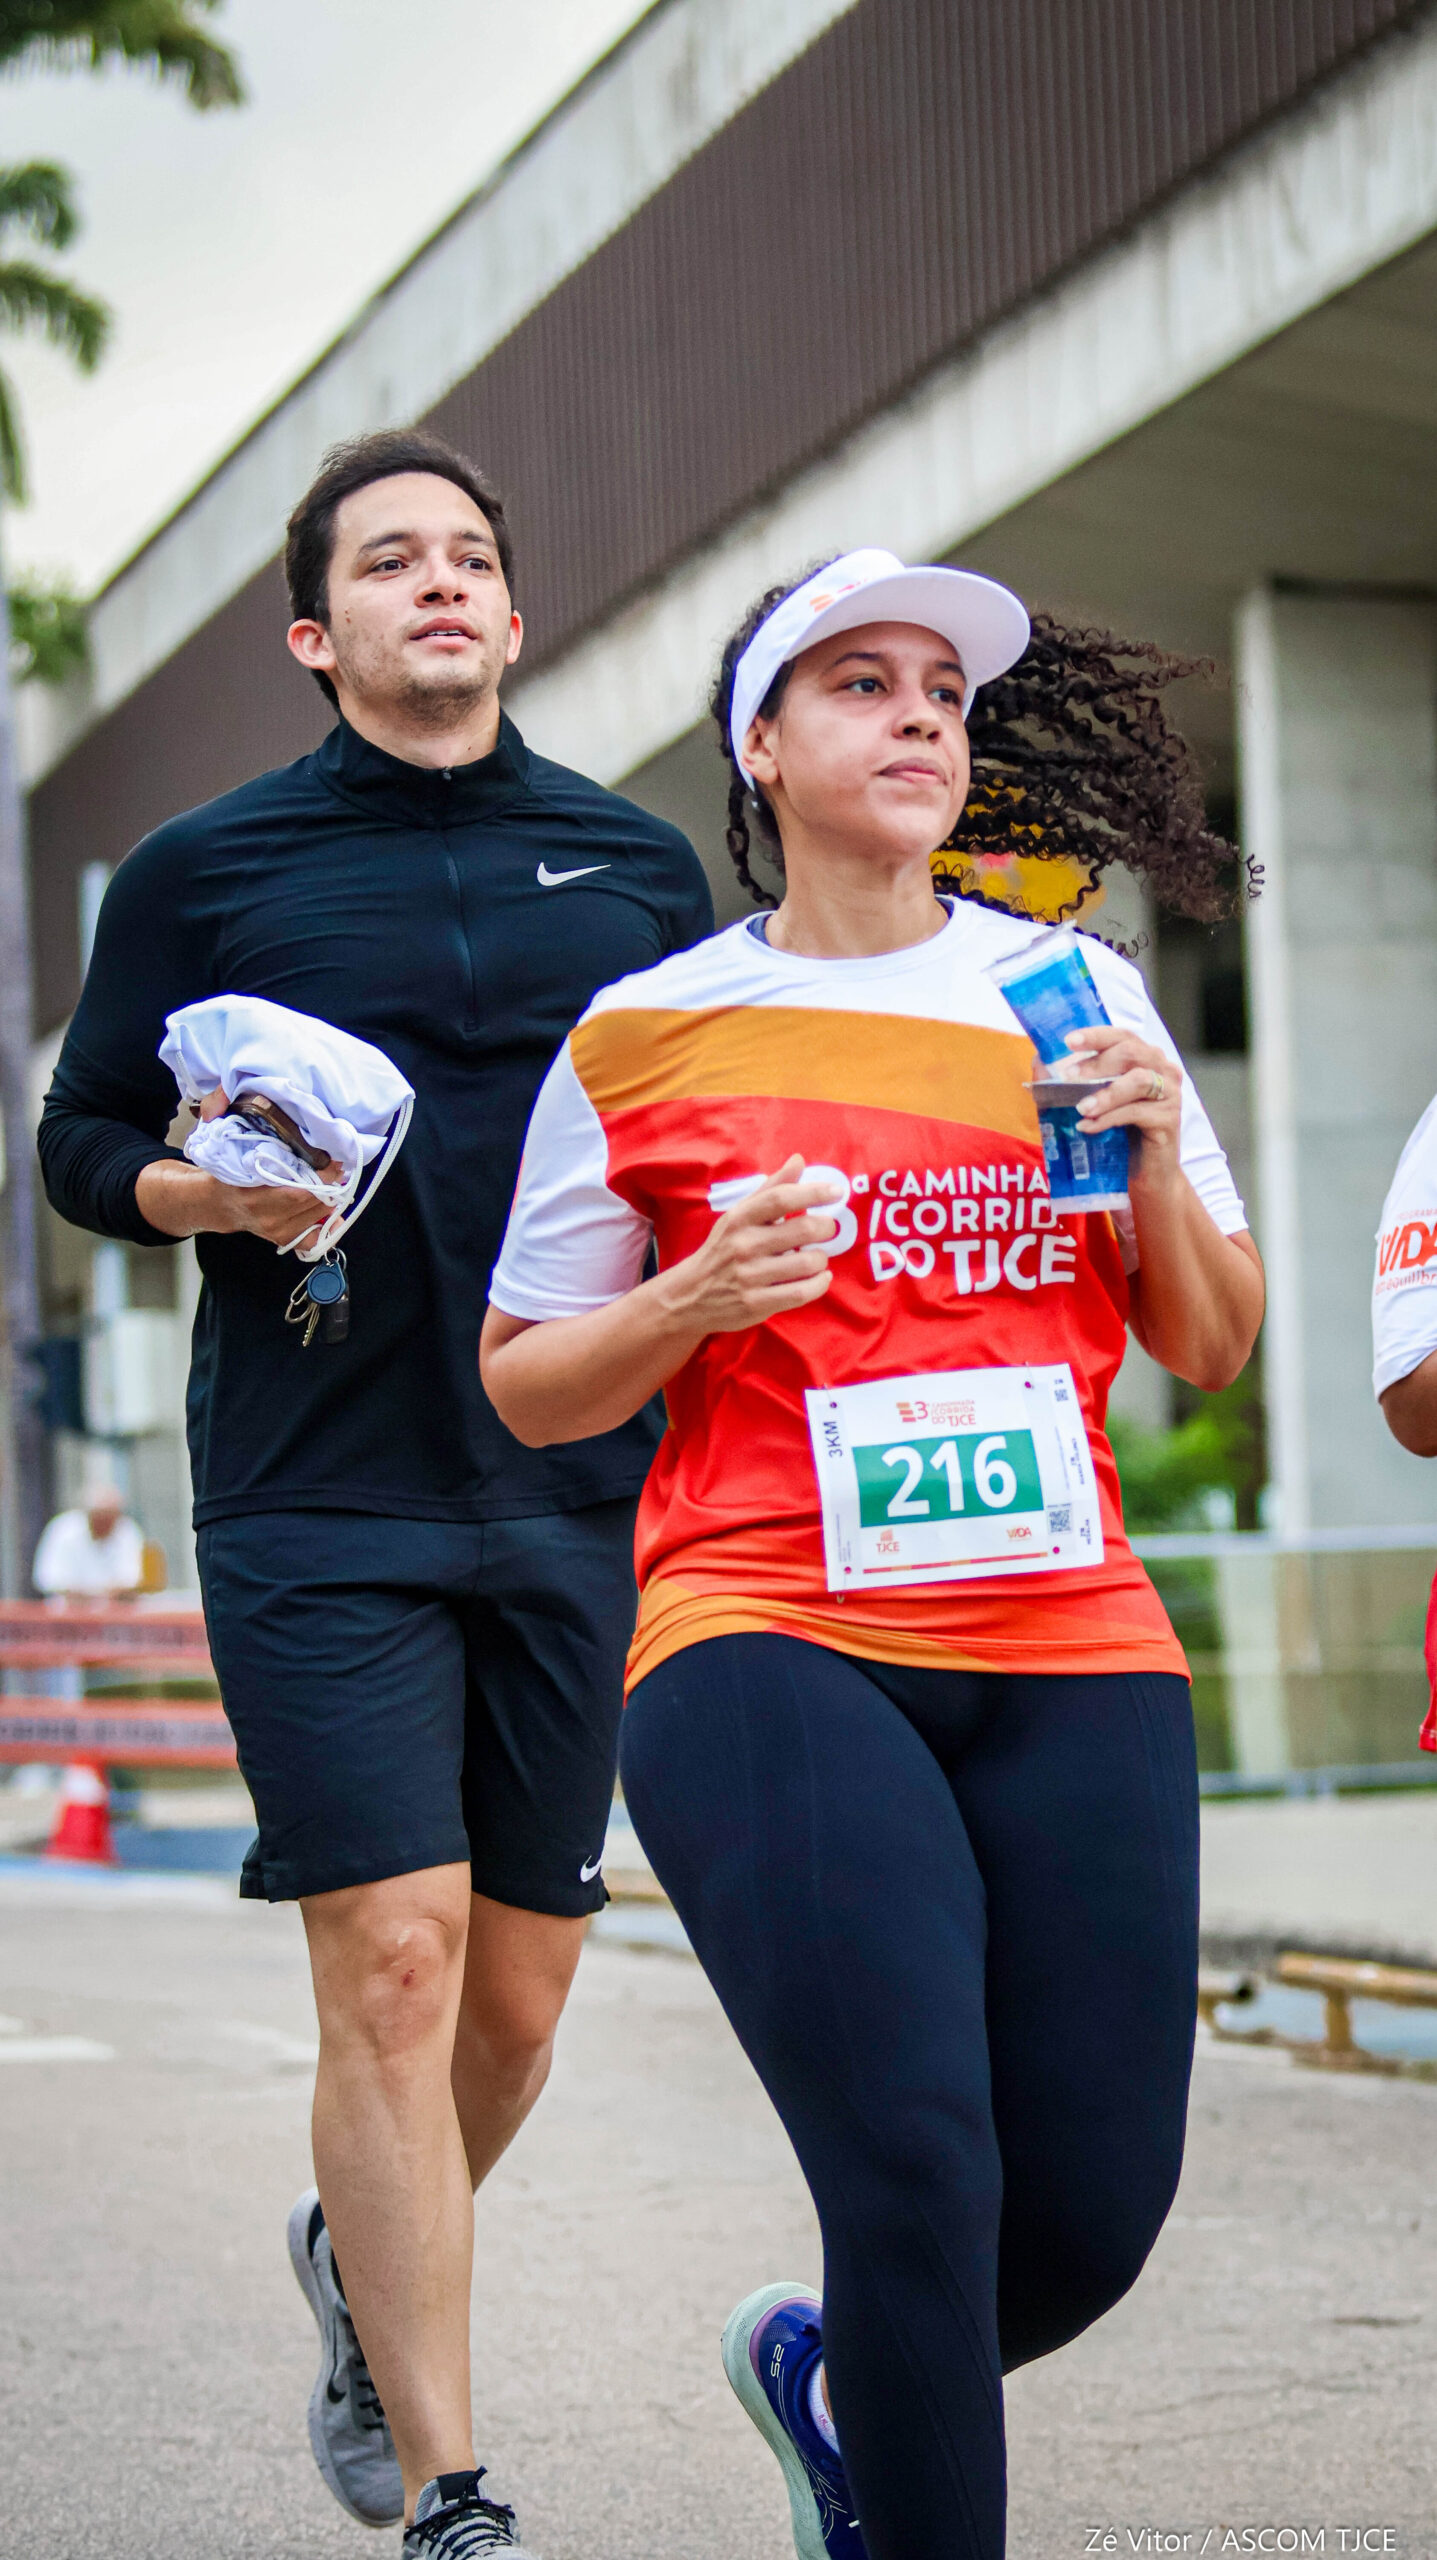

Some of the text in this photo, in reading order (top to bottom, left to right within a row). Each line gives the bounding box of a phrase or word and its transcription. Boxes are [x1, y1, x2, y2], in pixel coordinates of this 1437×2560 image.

[878, 1164, 1050, 1198] CAMINHA
[869, 1197, 1064, 1240] /CORRID
[869, 1233, 1077, 1295] DO TJCE
[948, 1414, 976, 1427] TJCE
[823, 1421, 843, 1458] 3KM
[881, 1435, 1018, 1518] 216
[876, 1541, 900, 1553] TJCE
